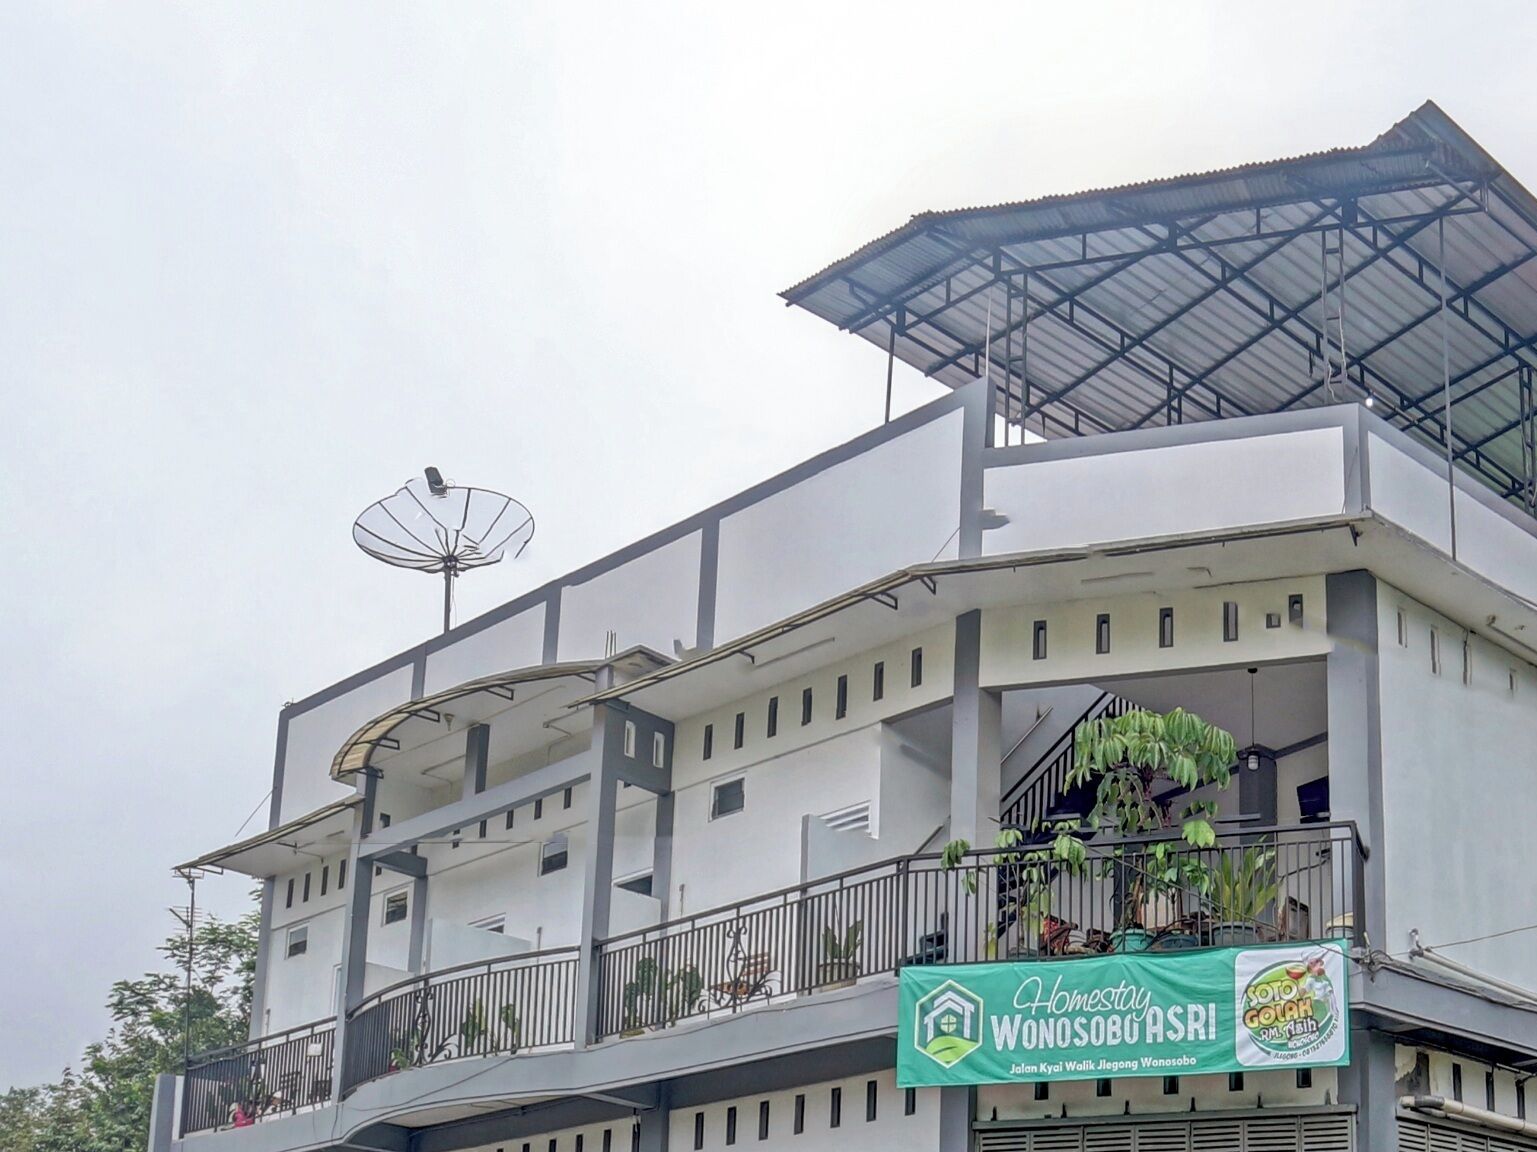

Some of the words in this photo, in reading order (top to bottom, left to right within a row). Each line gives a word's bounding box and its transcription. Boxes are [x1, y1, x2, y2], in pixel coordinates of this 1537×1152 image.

[1012, 974, 1151, 1022] Homestay
[1246, 980, 1298, 1007] SOTO
[990, 1012, 1140, 1051] WONOSOBO
[1145, 1002, 1216, 1044] ASRI
[1009, 1063, 1038, 1075] Jalan
[1039, 1061, 1063, 1075] Kyai
[1065, 1058, 1096, 1072] Walik
[1096, 1058, 1138, 1071] Jlegong
[1140, 1055, 1197, 1068] Wonosobo
